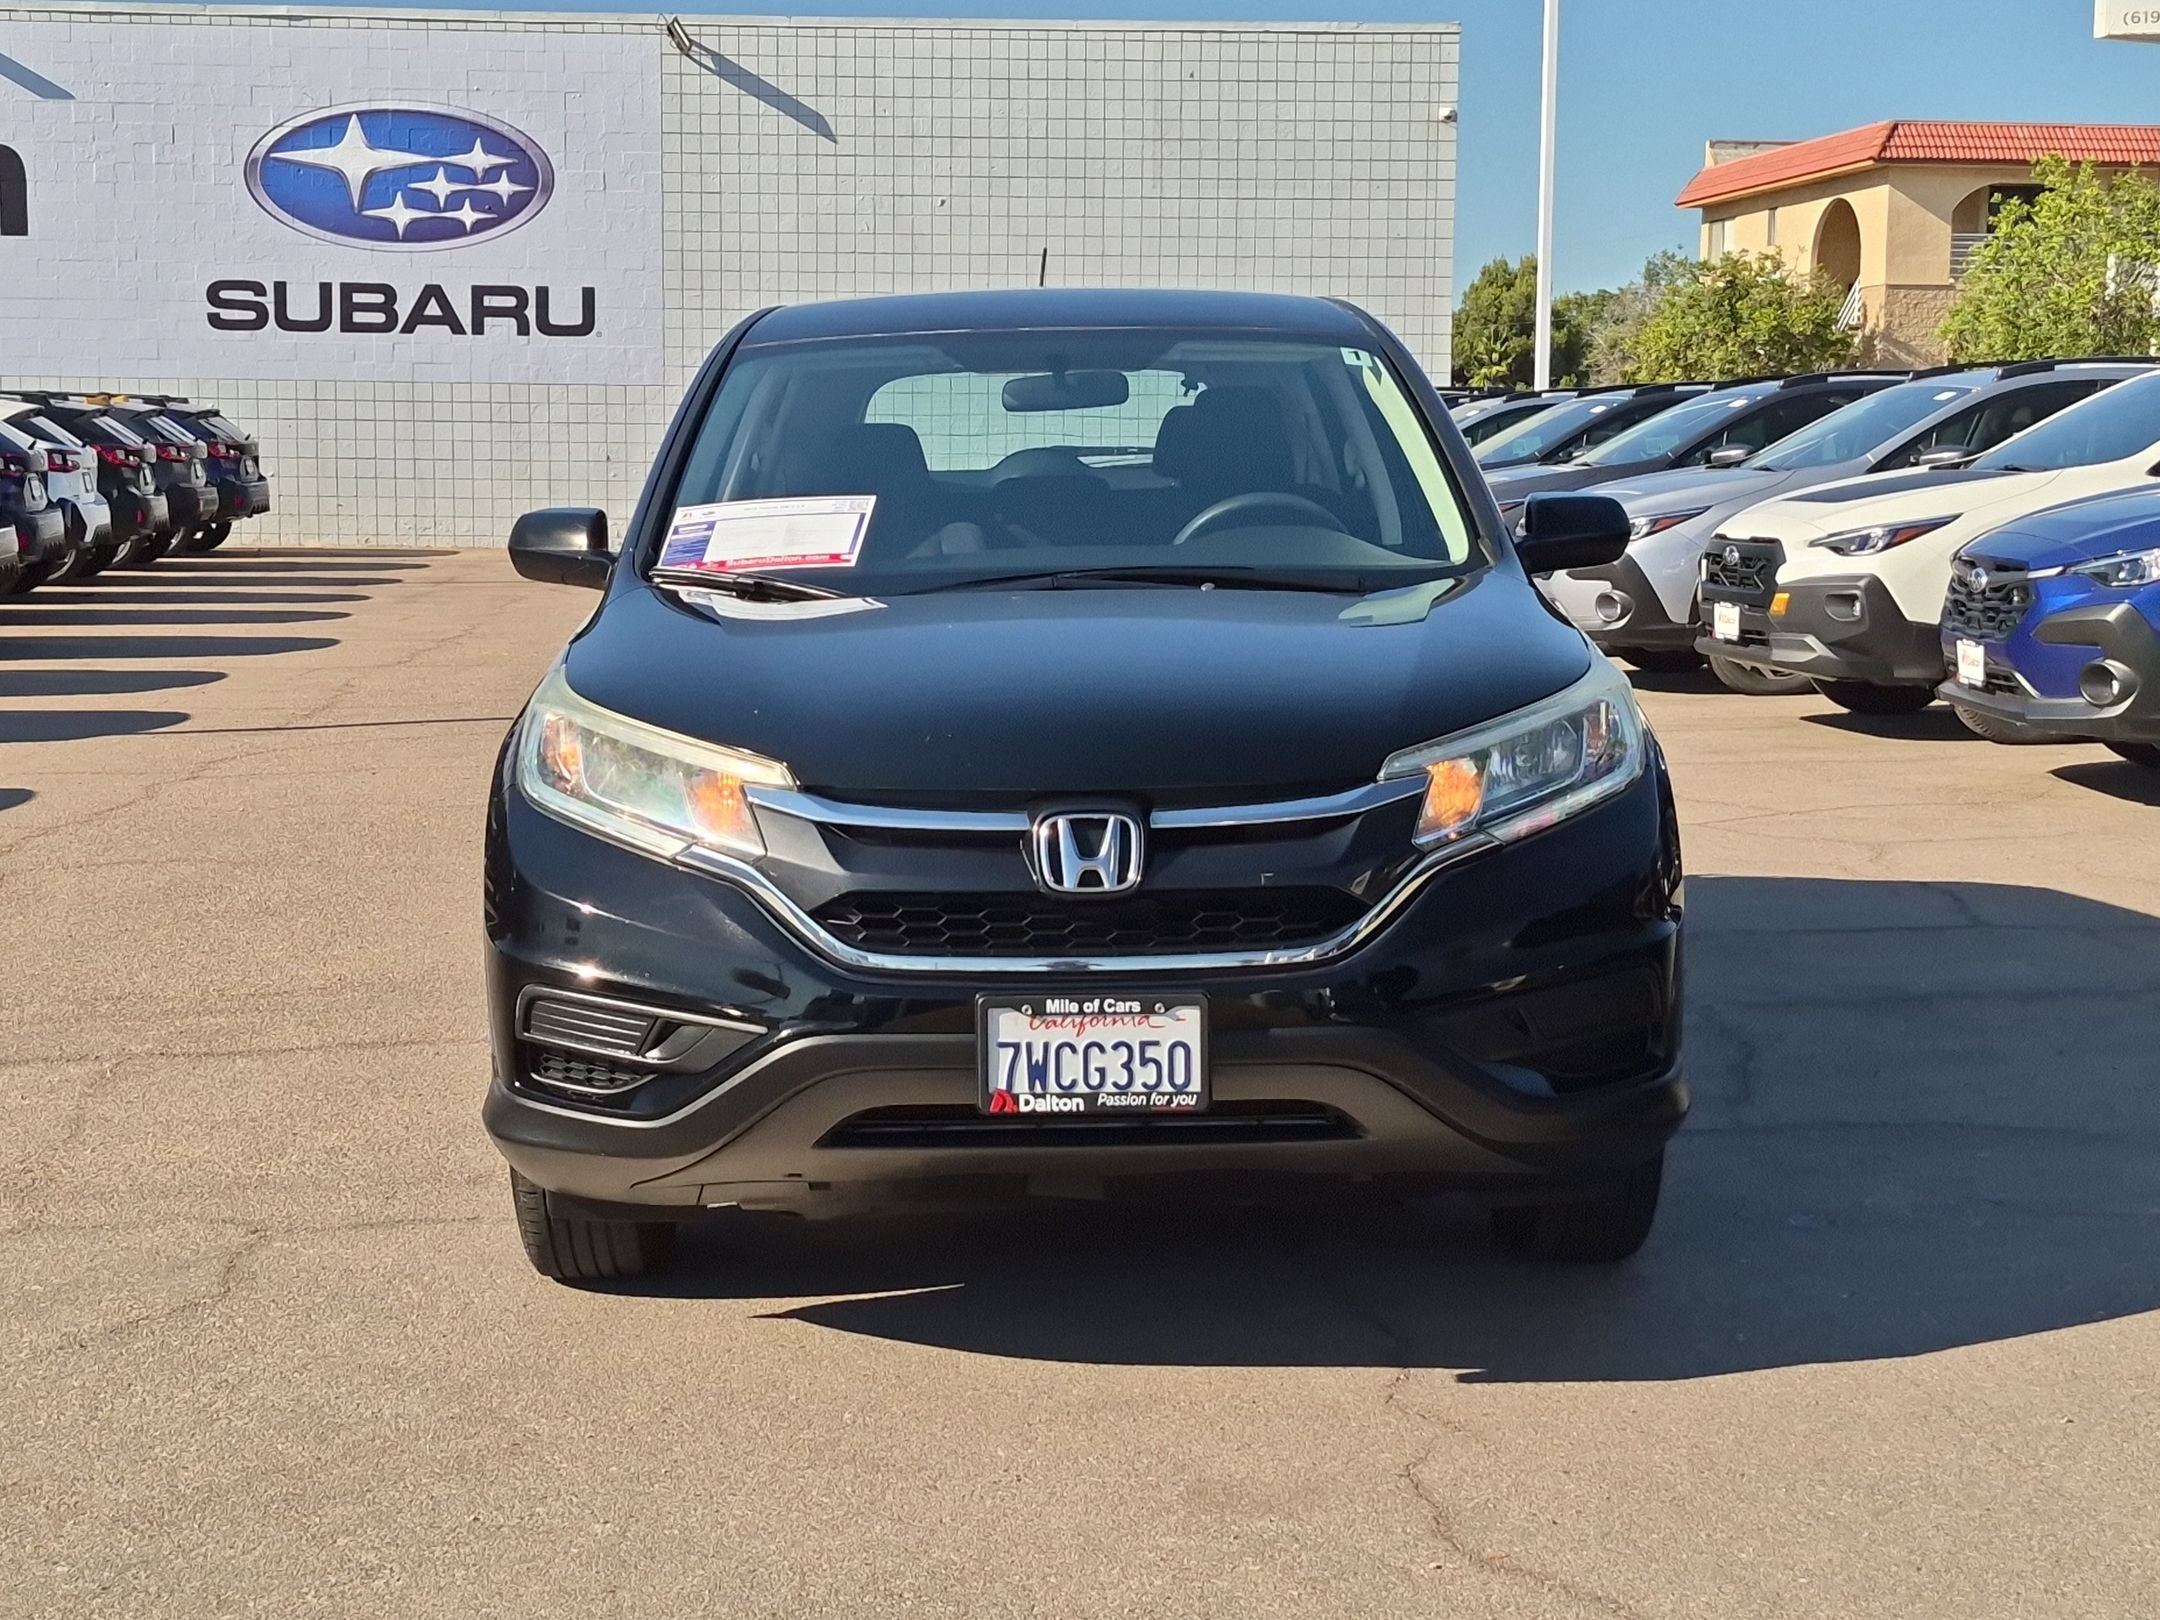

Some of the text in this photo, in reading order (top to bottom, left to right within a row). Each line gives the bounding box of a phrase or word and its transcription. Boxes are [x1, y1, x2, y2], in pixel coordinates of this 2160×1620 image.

[2123, 11, 2160, 26] (619
[206, 280, 596, 337] SUBARU
[1045, 998, 1141, 1014] Mile of Cars
[1029, 1014, 1166, 1037] California
[996, 1040, 1192, 1092] 7WCG350
[1018, 1094, 1085, 1112] Dalton
[1097, 1091, 1198, 1108] Passion for you
